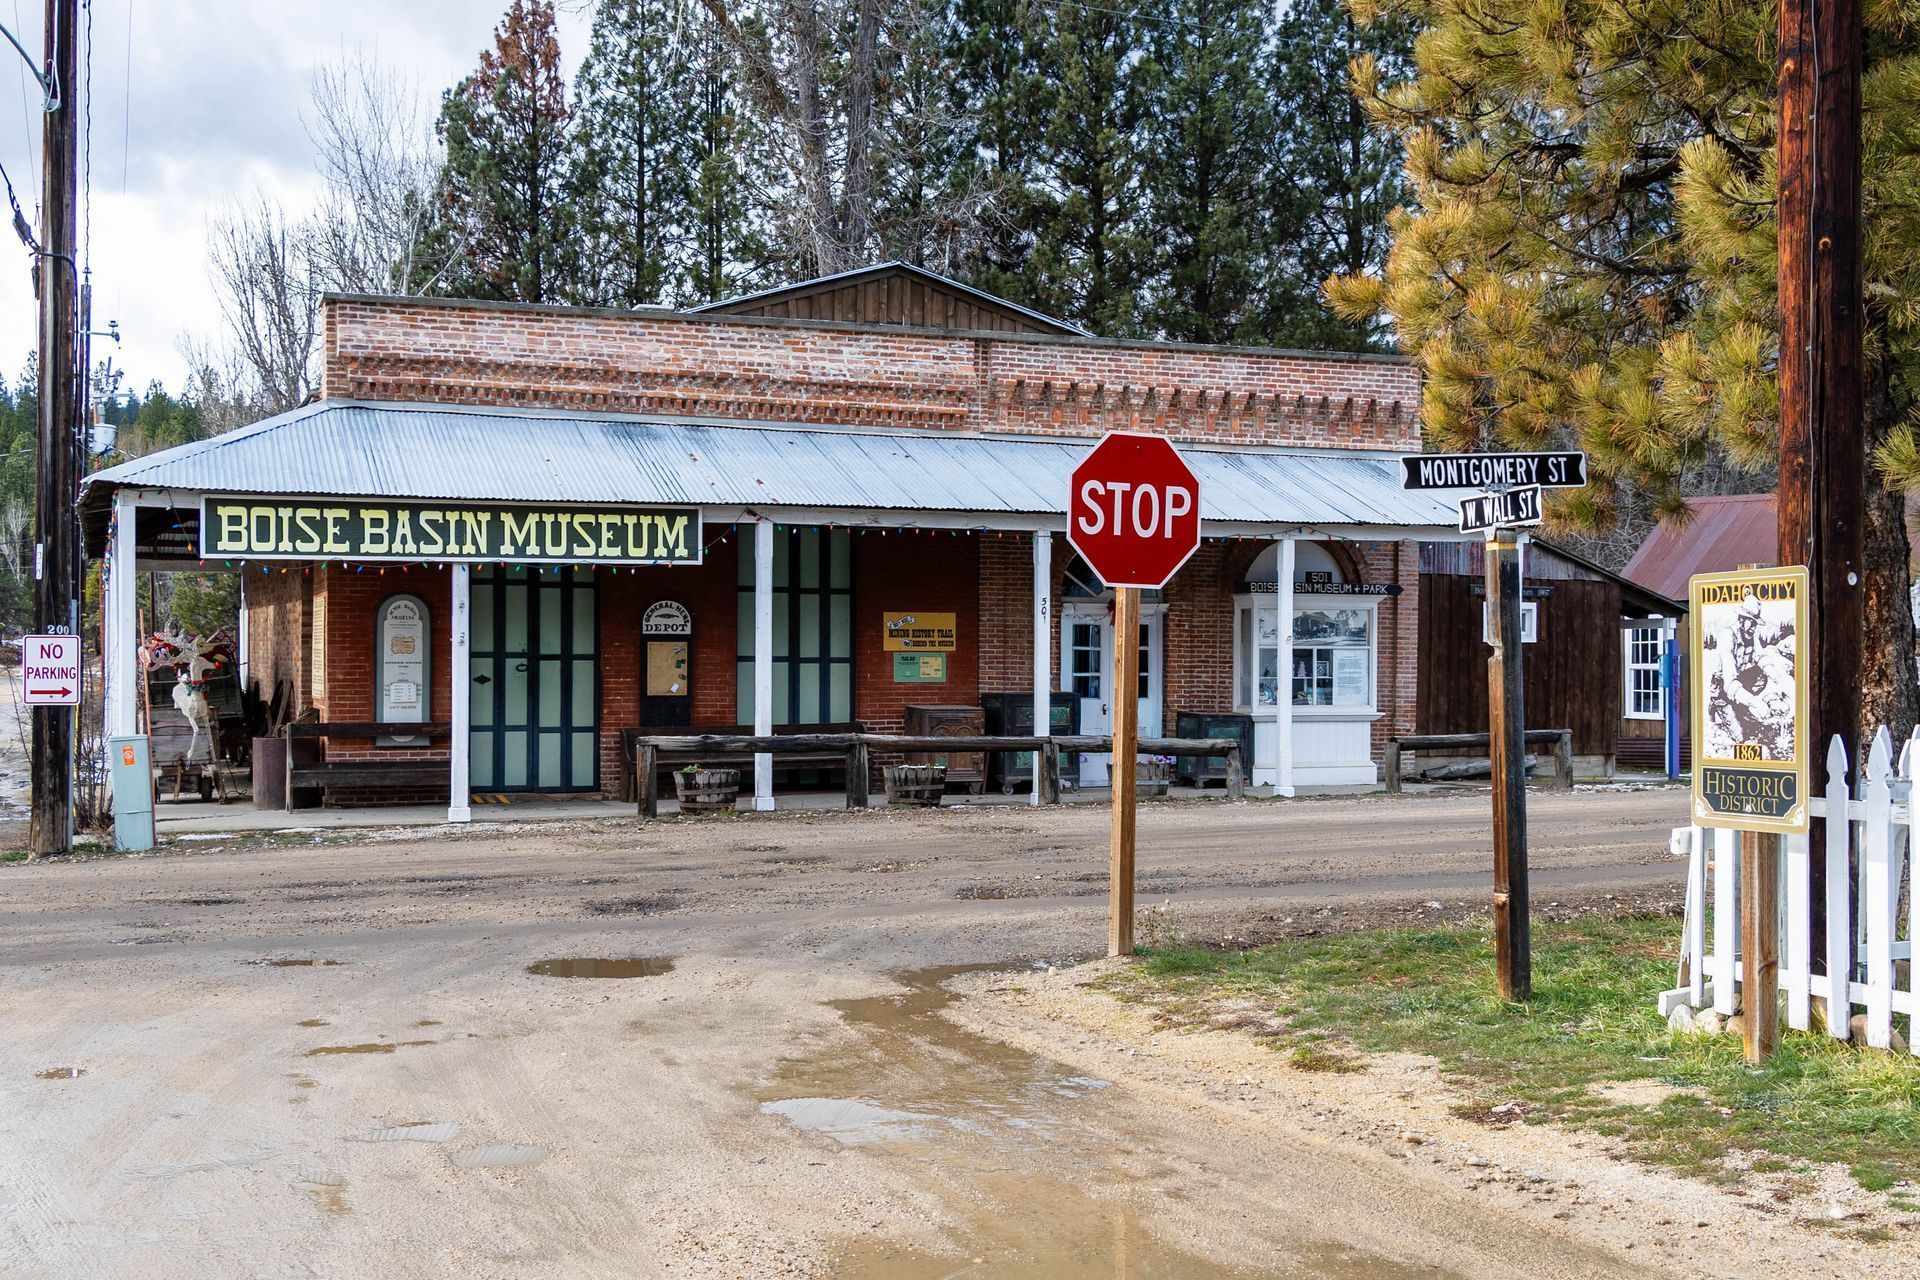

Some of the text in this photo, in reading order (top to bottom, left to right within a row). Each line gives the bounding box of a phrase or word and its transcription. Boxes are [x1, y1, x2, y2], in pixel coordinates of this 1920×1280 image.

[1420, 457, 1568, 486] MONTGOMERY ST
[1078, 480, 1192, 539] STOP
[1465, 491, 1534, 528] W. WALL ST
[217, 506, 689, 558] BOISE BASIN MUSEUM
[1294, 582, 1312, 593] SIN
[1314, 583, 1352, 594] MUSEUM
[1363, 585, 1388, 594] PARK
[1312, 572, 1328, 583] 501
[1702, 580, 1796, 604] IDAHO CITY
[644, 602, 674, 624] GENERAL
[47, 624, 69, 636] 200
[645, 623, 688, 632] DEPOT
[40, 644, 63, 660] NO
[27, 666, 77, 680] PARKING
[1734, 745, 1762, 761] 1862
[1705, 770, 1795, 801] HISTORIC
[1719, 794, 1779, 815] DISTRICT
